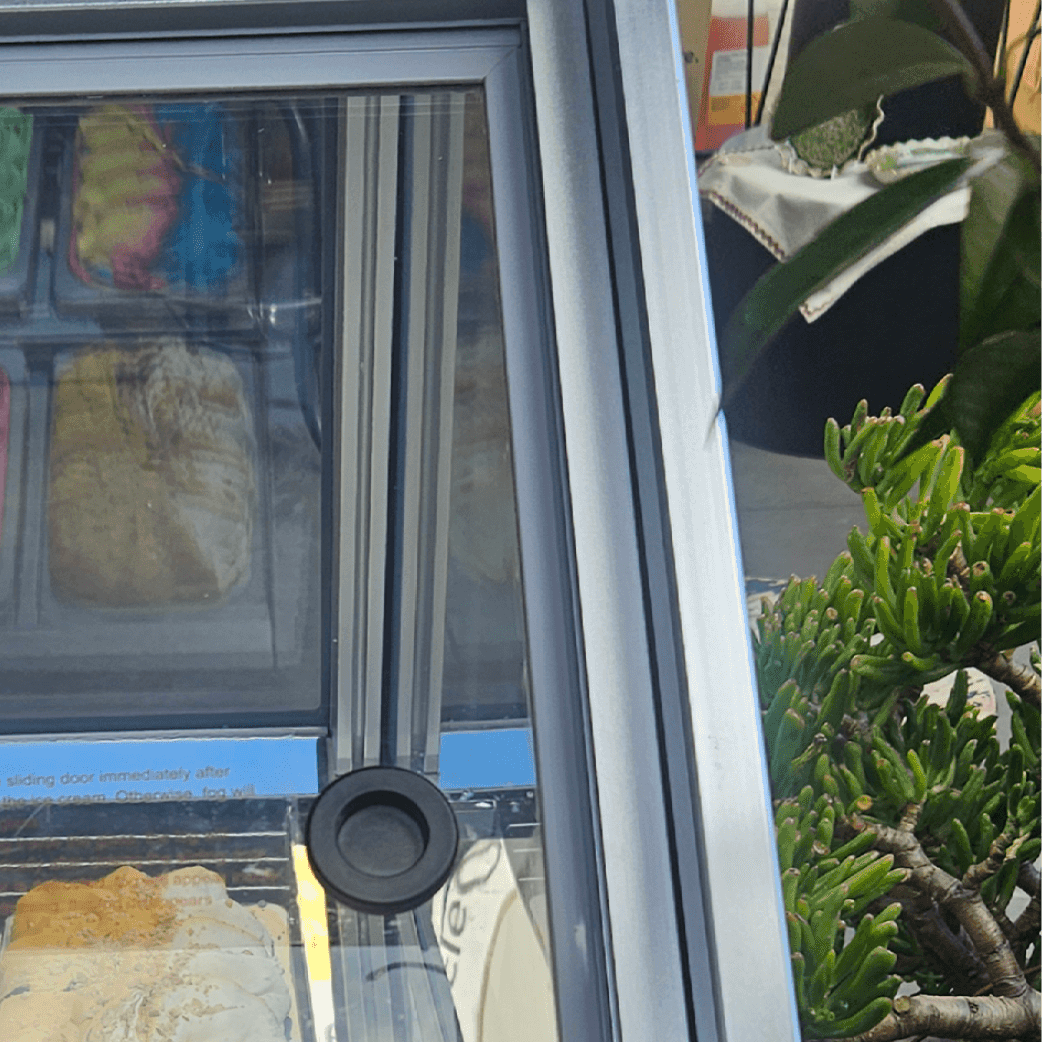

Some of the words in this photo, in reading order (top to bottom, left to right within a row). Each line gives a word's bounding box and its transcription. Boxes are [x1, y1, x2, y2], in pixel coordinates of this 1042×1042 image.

[6, 773, 56, 789] sliding
[59, 772, 95, 786] door
[99, 767, 191, 783] immediately
[195, 766, 231, 780] after
